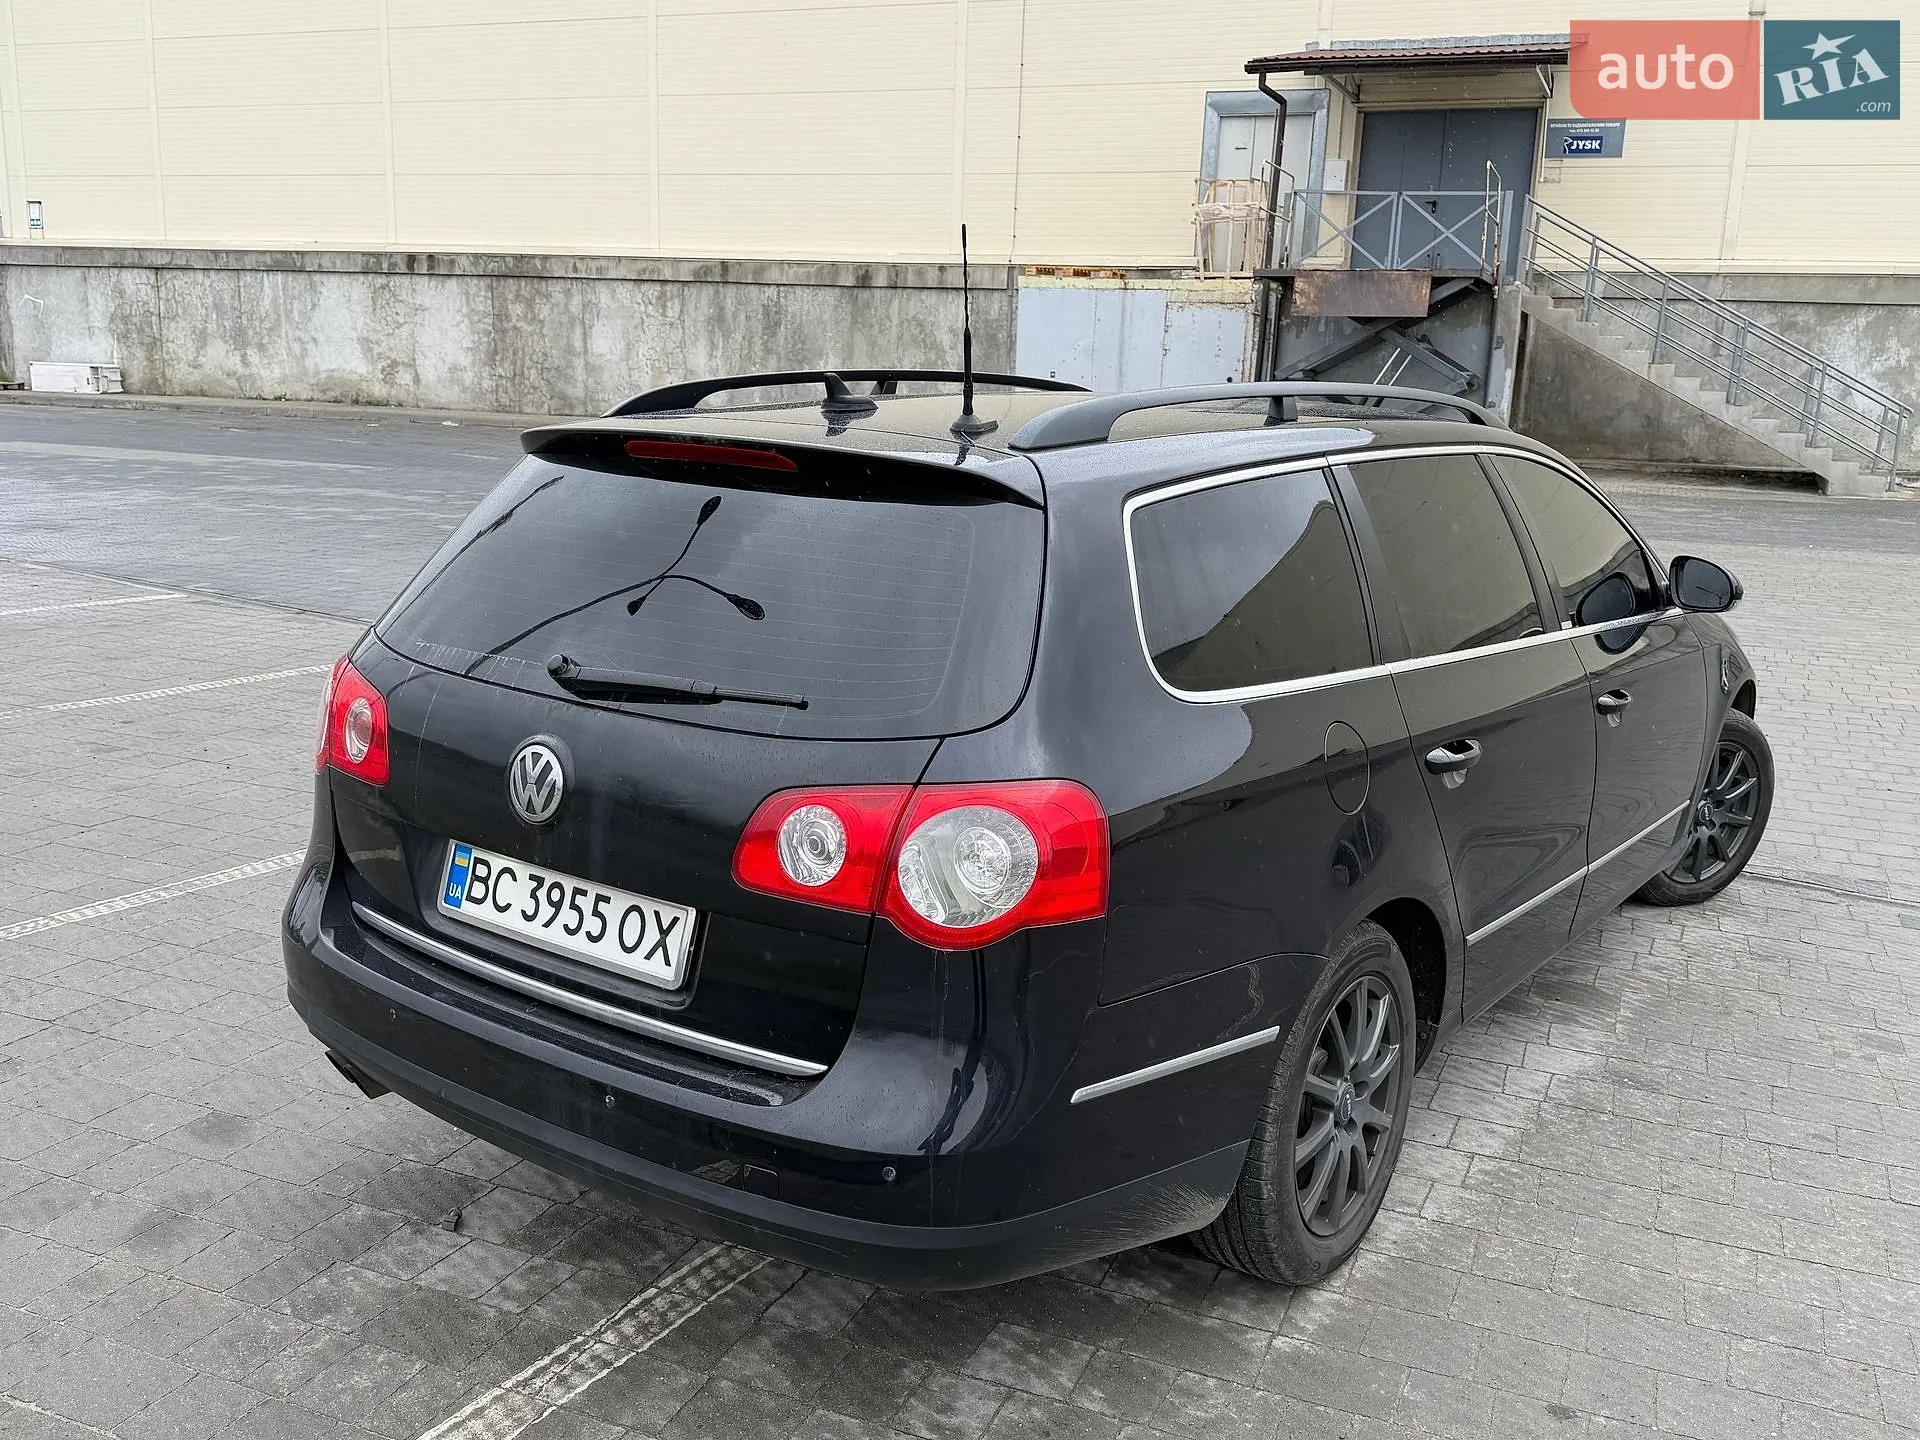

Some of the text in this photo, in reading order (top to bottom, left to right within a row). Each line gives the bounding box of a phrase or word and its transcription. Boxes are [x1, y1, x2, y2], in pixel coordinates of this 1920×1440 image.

[1570, 139, 1601, 150] JYSK
[448, 882, 462, 900] UA
[464, 855, 681, 968] BC 3955 OX
